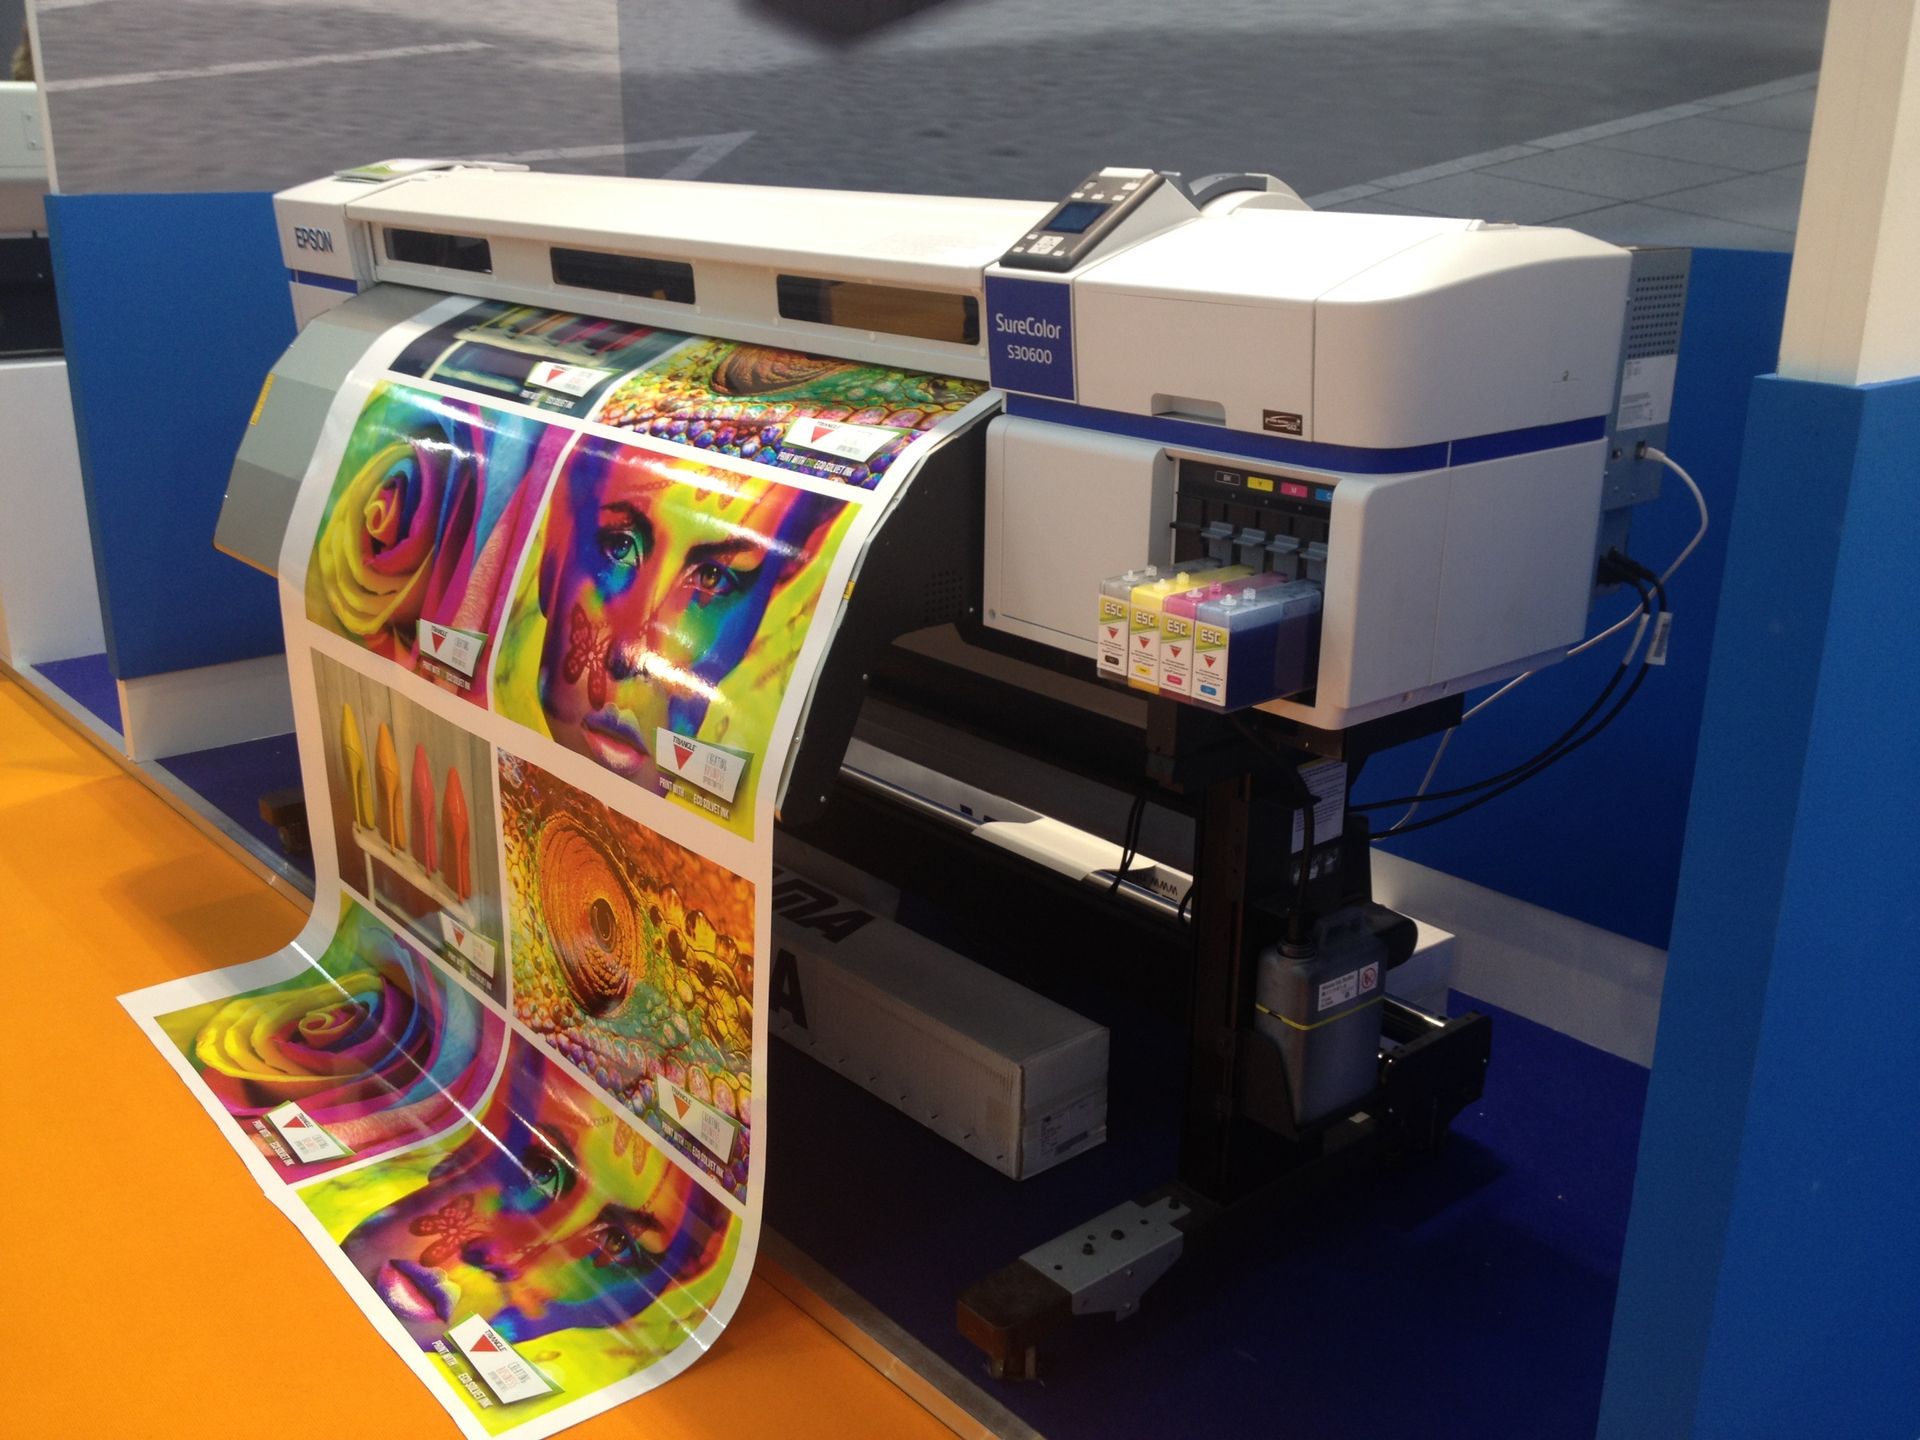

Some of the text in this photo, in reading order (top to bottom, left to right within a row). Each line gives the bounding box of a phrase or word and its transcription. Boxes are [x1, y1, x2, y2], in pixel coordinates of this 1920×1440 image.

[294, 226, 334, 253] EPSON
[995, 312, 1062, 340] SureColor
[1007, 344, 1053, 365] S30600
[1104, 601, 1123, 617] ESC
[1135, 611, 1154, 627] ESC
[1167, 618, 1187, 636] ESC
[1201, 628, 1221, 645] ESC
[673, 735, 696, 752] TRIANGLE
[485, 1329, 508, 1352] TRIANGLE
